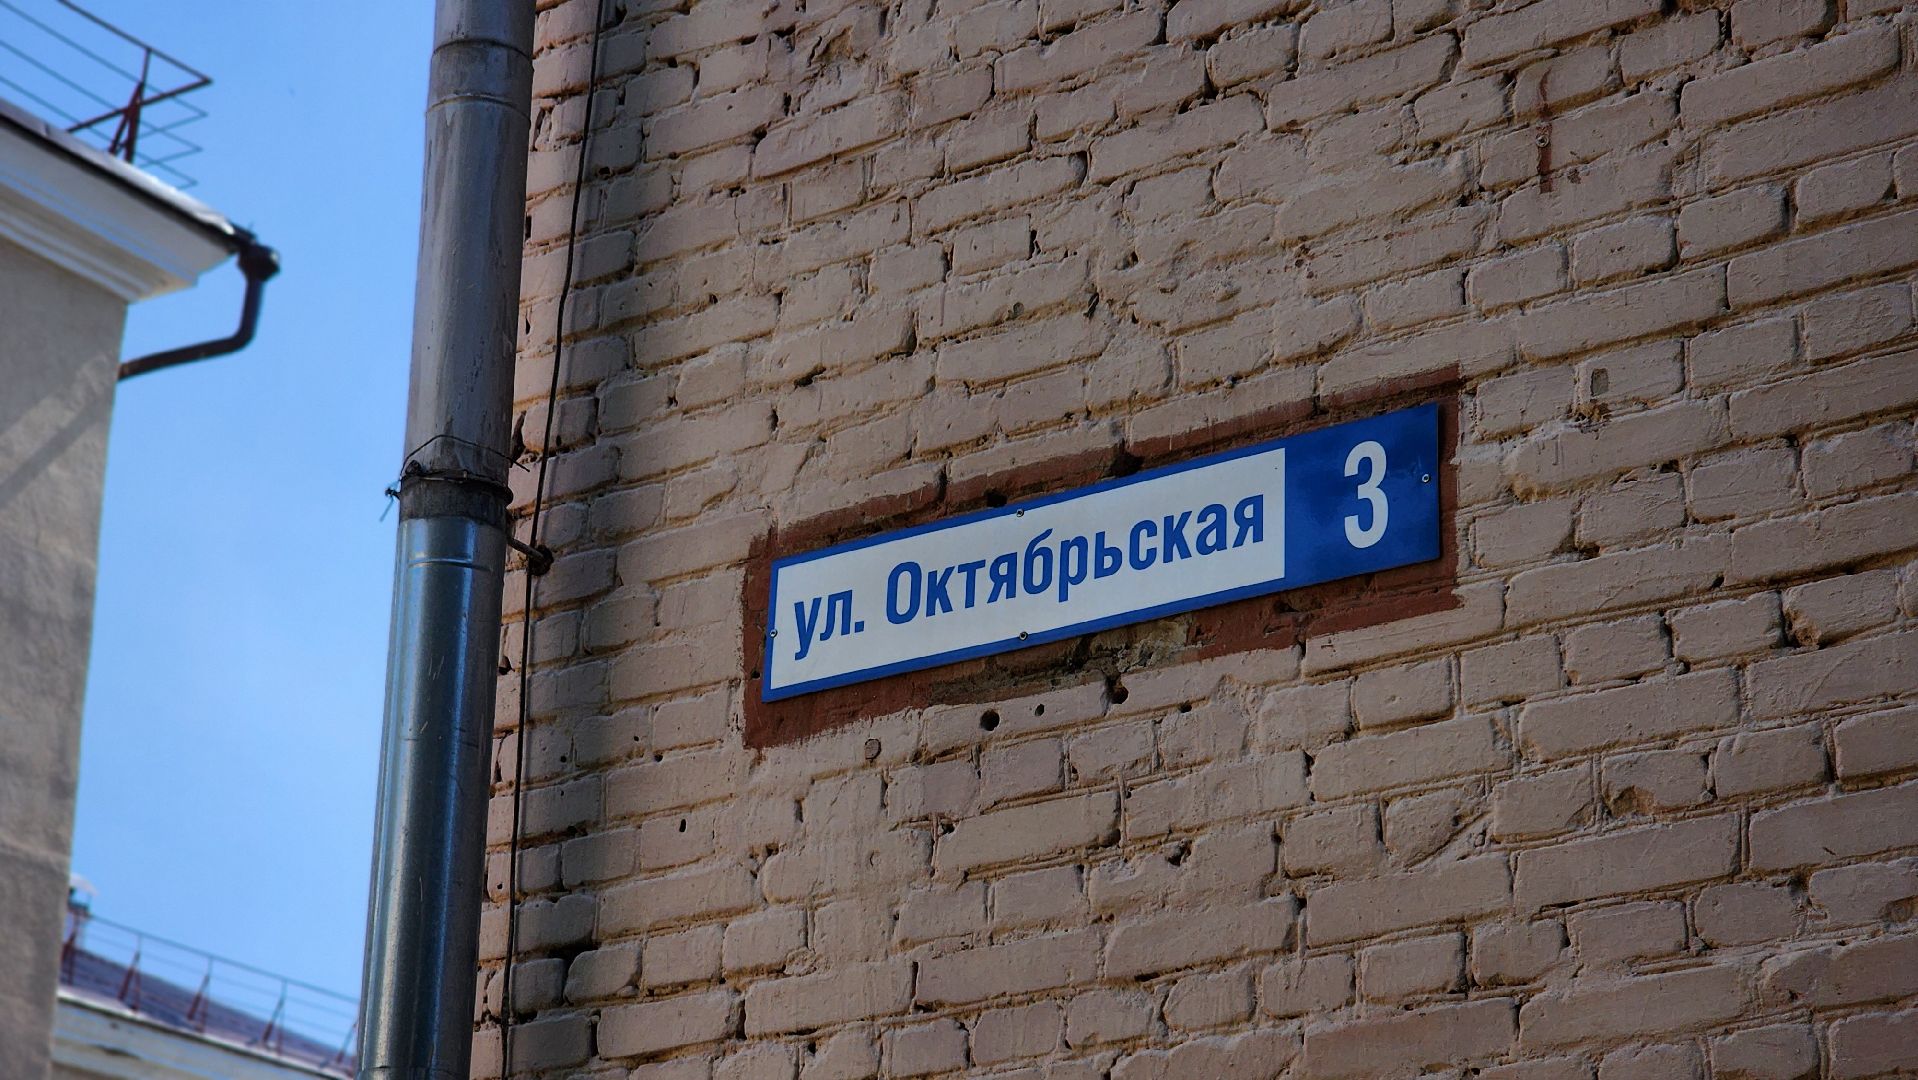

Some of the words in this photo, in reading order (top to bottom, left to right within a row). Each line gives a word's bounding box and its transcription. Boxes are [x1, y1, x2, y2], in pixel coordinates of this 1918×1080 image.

[794, 589, 865, 660] ул.
[886, 494, 1264, 625] Октябрьская
[1343, 440, 1389, 549] 3
